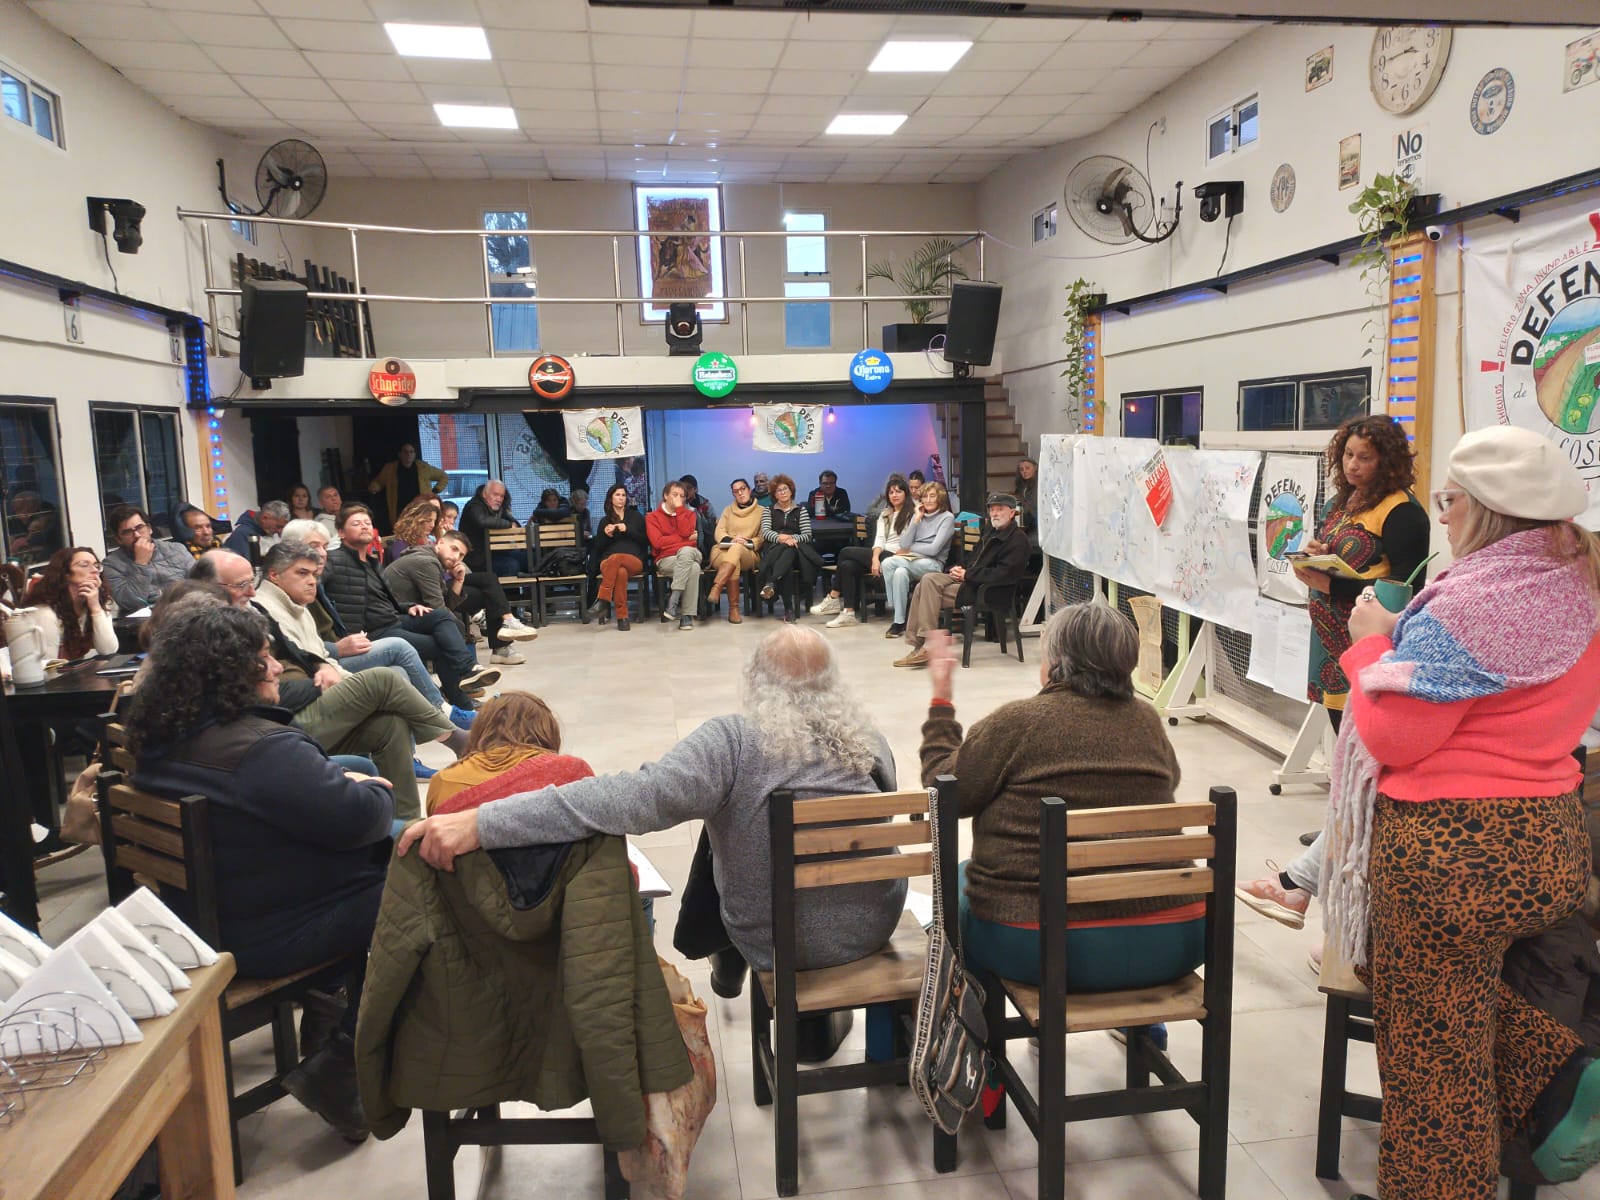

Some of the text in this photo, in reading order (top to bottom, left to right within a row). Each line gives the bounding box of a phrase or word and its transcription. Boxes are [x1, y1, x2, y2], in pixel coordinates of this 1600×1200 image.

[1382, 30, 1392, 51] 10
[1378, 55, 1386, 72] 9
[1421, 53, 1431, 69] 4
[1381, 73, 1389, 91] 8
[1413, 71, 1421, 90] 5
[1401, 83, 1409, 101] 6
[1397, 130, 1423, 159] No
[1497, 241, 1589, 357] PELIGRO ZONA INUNDABLE
[71, 313, 78, 340] 6
[854, 364, 890, 378] Corona
[371, 372, 414, 391] Schneider
[1513, 382, 1528, 399] de
[1494, 384, 1506, 426] EHICULOS
[611, 411, 629, 455] DEFENSAS
[798, 408, 815, 449] DEFENSAS
[1264, 478, 1309, 514] DEFENSAS
